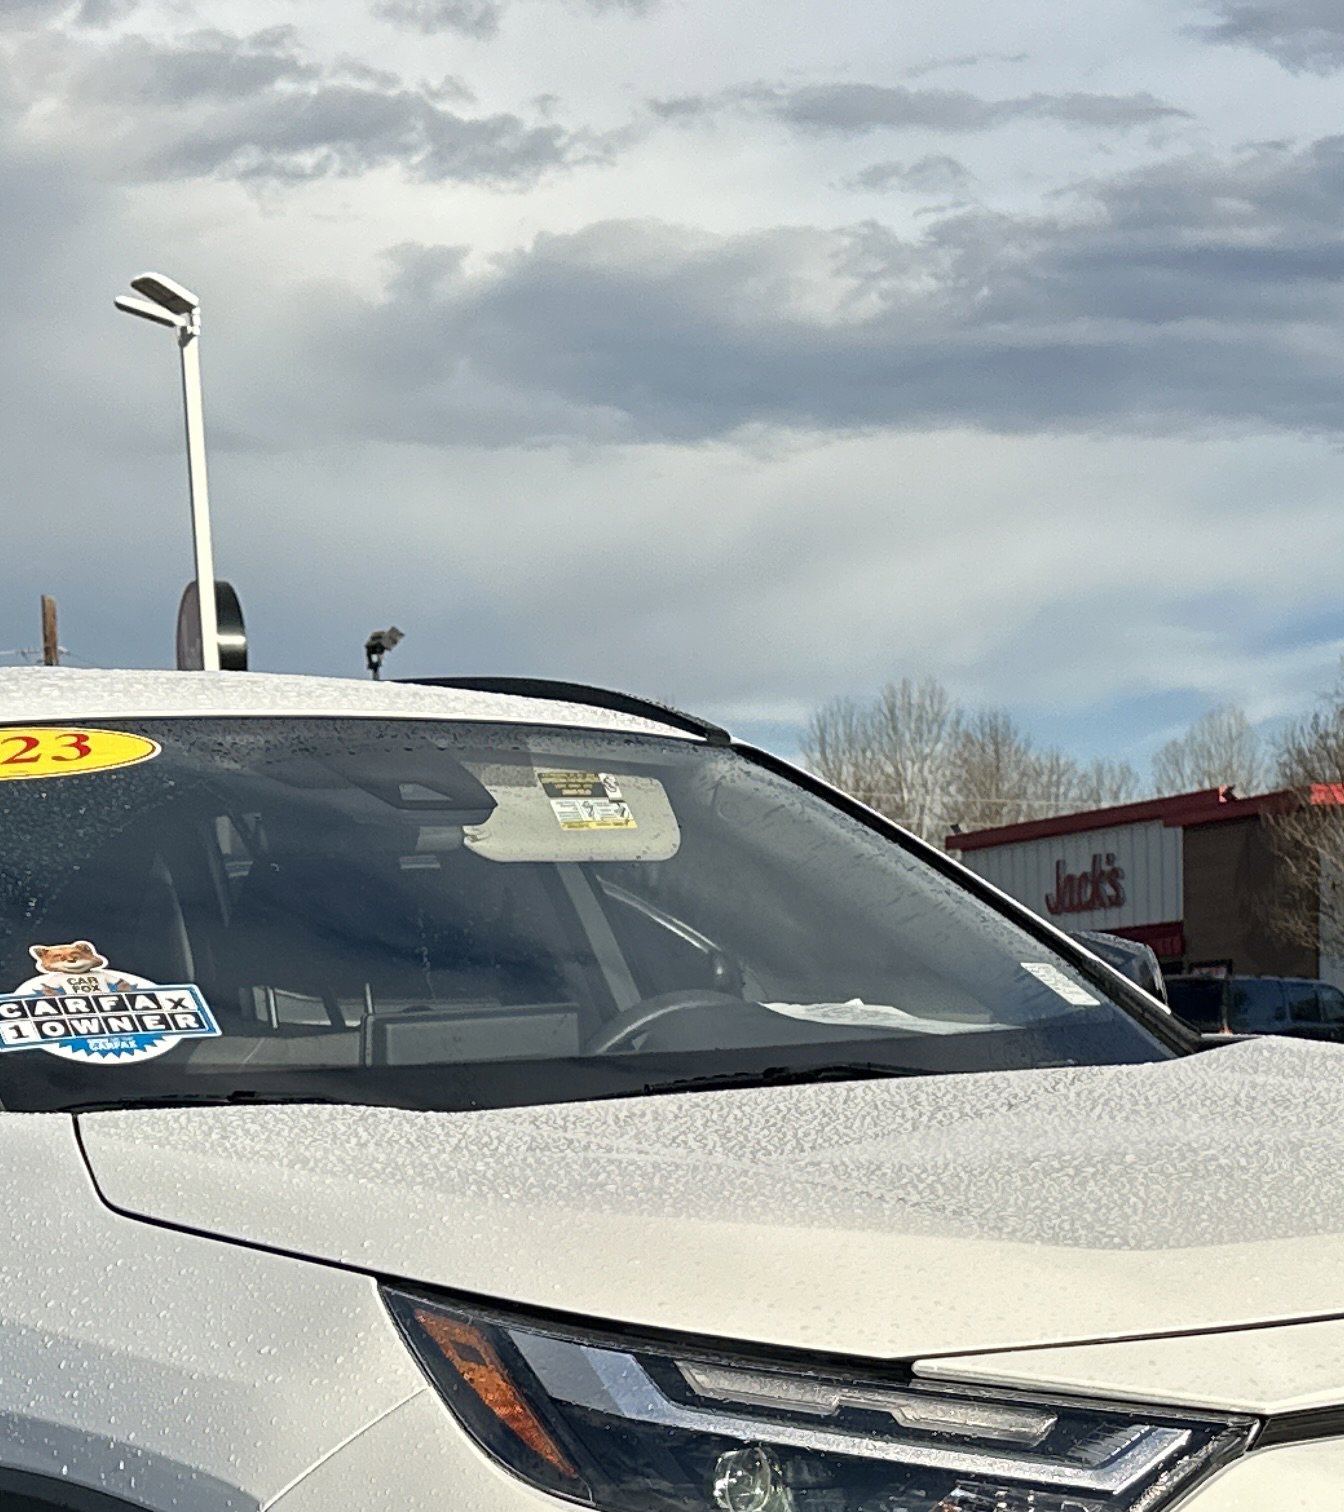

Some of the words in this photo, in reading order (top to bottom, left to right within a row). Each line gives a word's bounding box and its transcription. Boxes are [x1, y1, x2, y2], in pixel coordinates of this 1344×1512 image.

[1045, 853, 1126, 915] Jack's
[67, 976, 99, 986] CAR
[72, 984, 101, 993] FOX
[0, 995, 190, 1018] CARFAX
[8, 1024, 30, 1040] 1
[42, 1013, 199, 1037] OWNER
